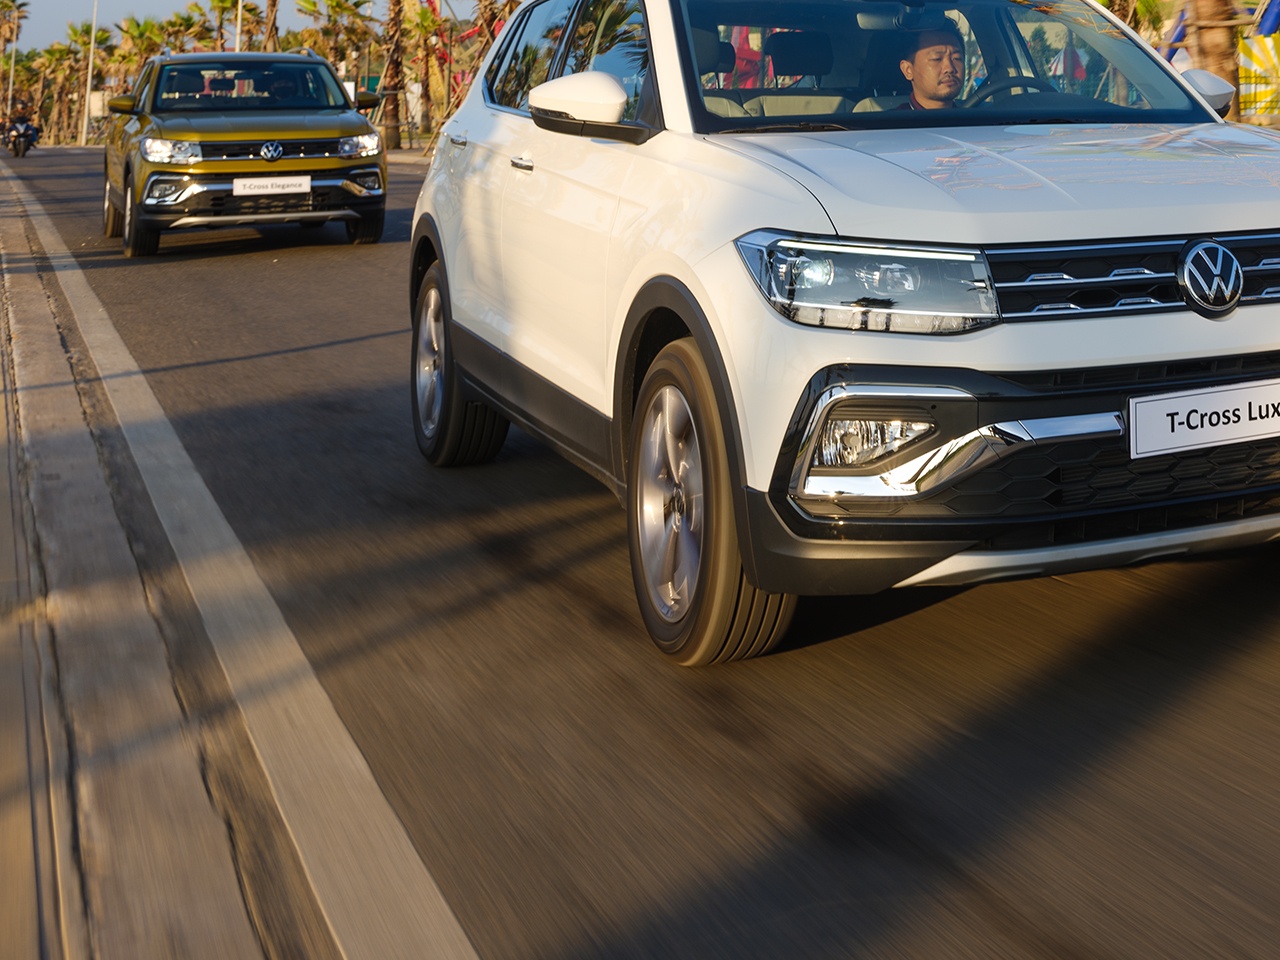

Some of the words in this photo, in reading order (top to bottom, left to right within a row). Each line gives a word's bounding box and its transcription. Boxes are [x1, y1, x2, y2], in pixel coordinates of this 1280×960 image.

[242, 183, 269, 191] T-Cross
[270, 182, 303, 190] Elegance
[1166, 407, 1241, 433] T-Cross
